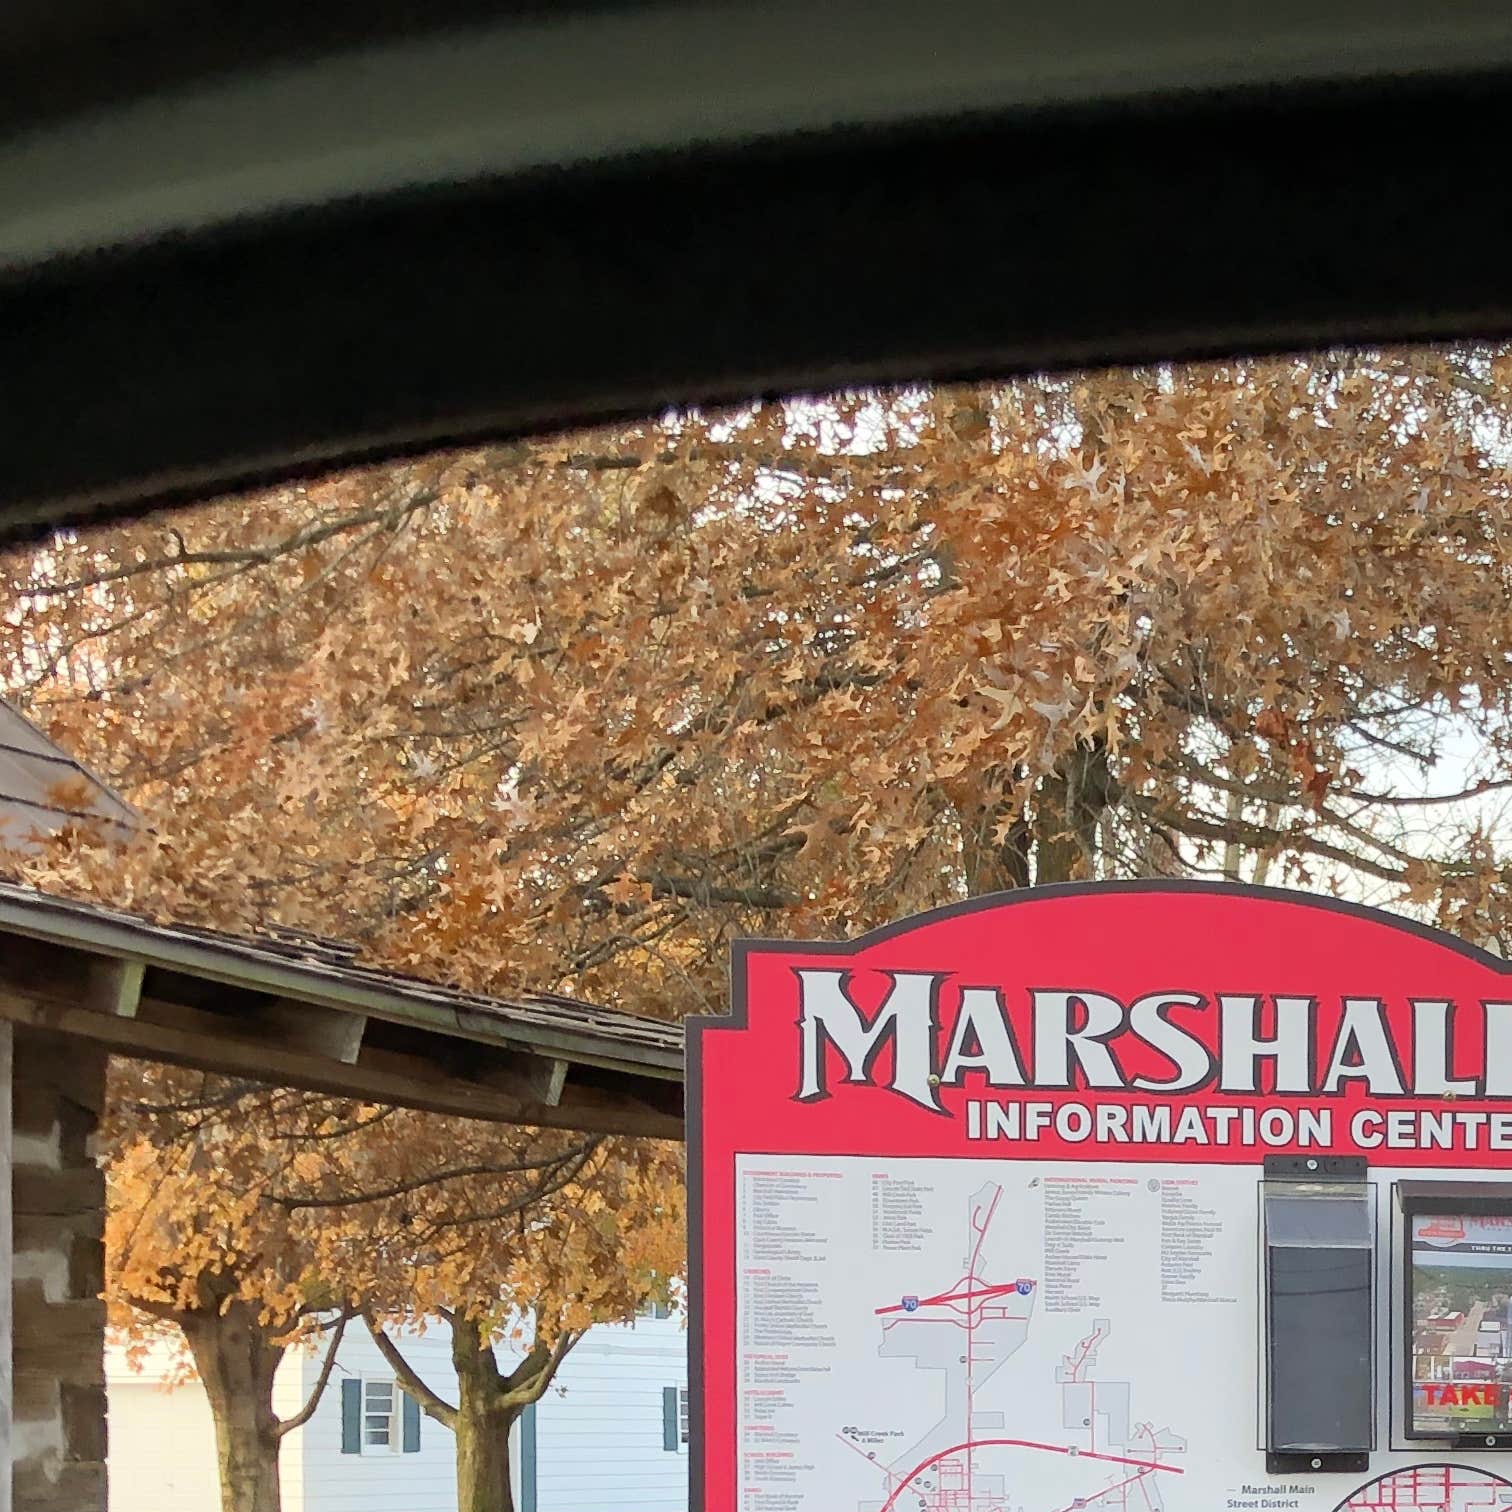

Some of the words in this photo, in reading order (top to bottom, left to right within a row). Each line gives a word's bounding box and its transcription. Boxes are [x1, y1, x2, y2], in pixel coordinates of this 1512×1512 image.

[967, 1100, 1332, 1148] INFORMATION
[1421, 1384, 1500, 1406] TAKE
[1241, 1484, 1287, 1495] Marshall
[1289, 1485, 1315, 1494] Main
[1227, 1499, 1259, 1508] Street
[1261, 1499, 1299, 1508] District
